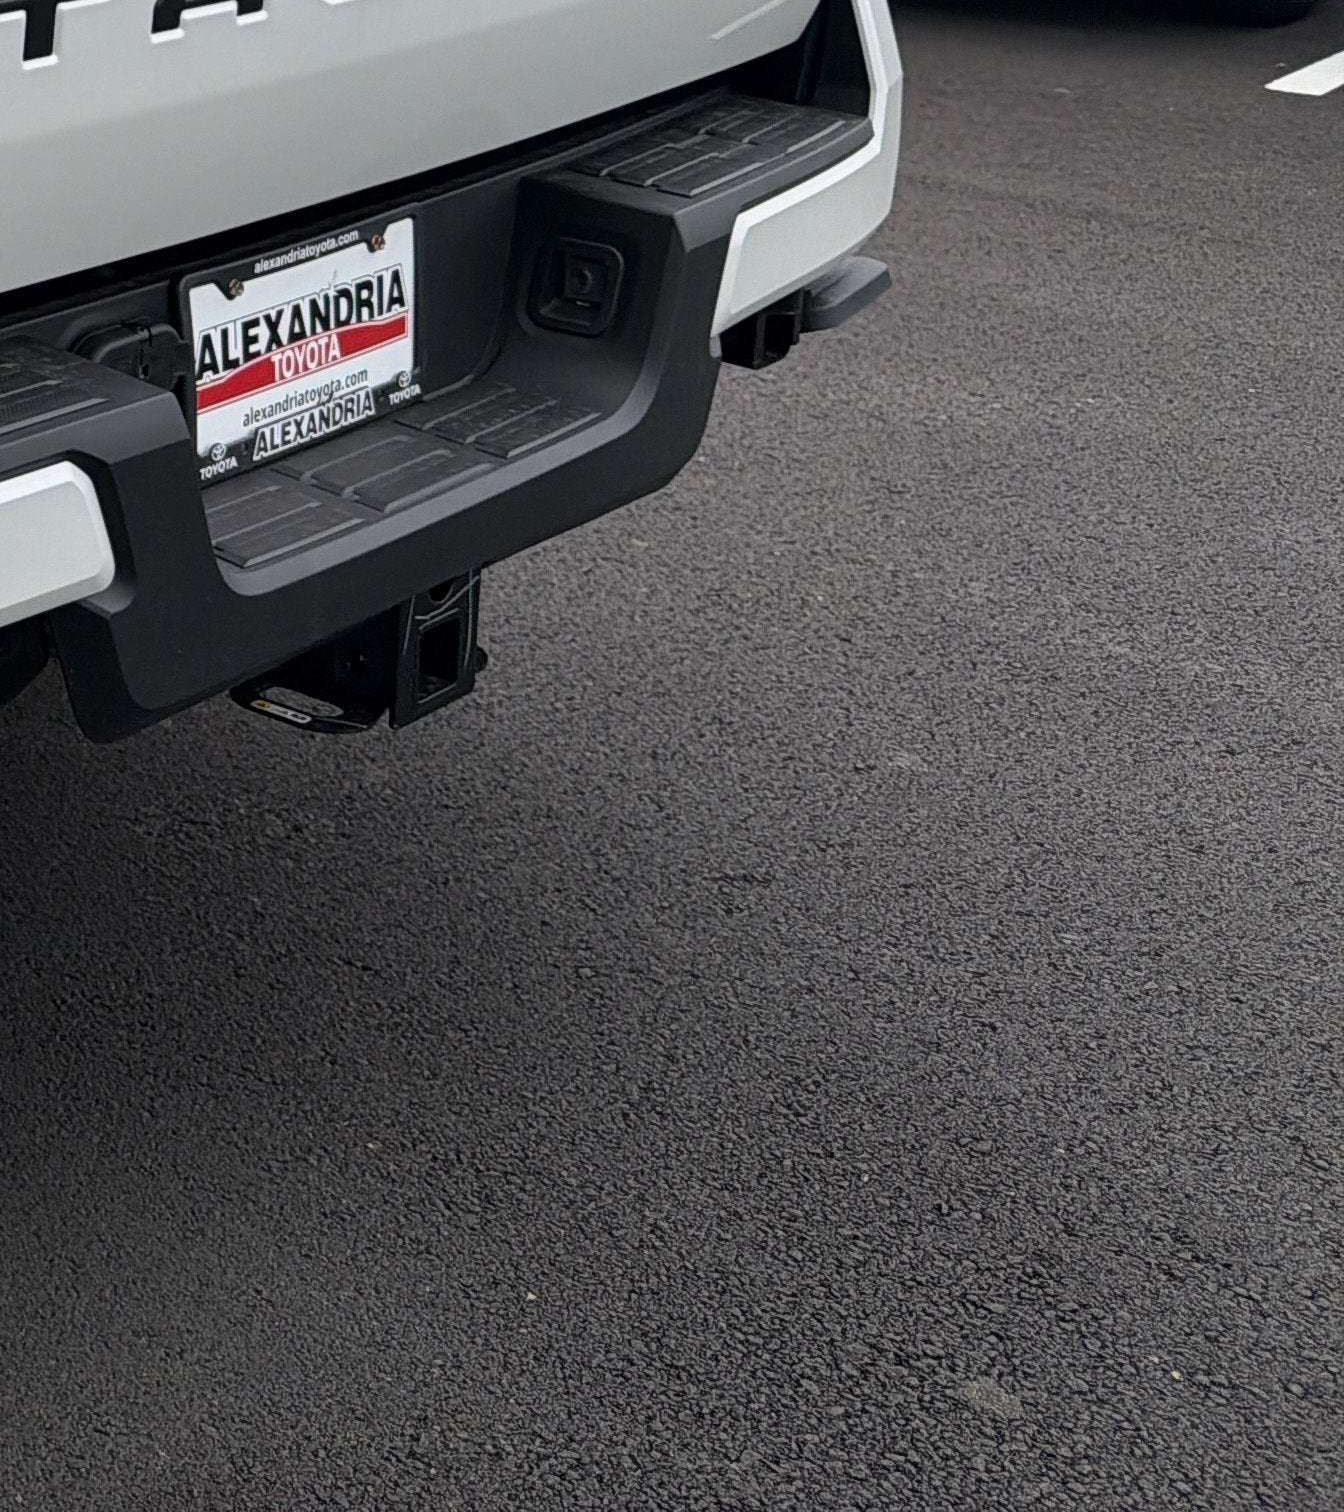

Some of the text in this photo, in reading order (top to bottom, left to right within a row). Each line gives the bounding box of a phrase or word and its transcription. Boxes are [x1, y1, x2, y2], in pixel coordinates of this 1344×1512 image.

[253, 229, 359, 274] alexandriatoyota.com
[196, 267, 407, 381] ALEXANDRIA
[271, 333, 342, 382] TOYOTA
[242, 368, 368, 428] alexandriatoyota.com
[388, 383, 422, 406] TOYOTA
[254, 389, 375, 460] ALEXANDRIA
[199, 456, 239, 481] TOYOTA
